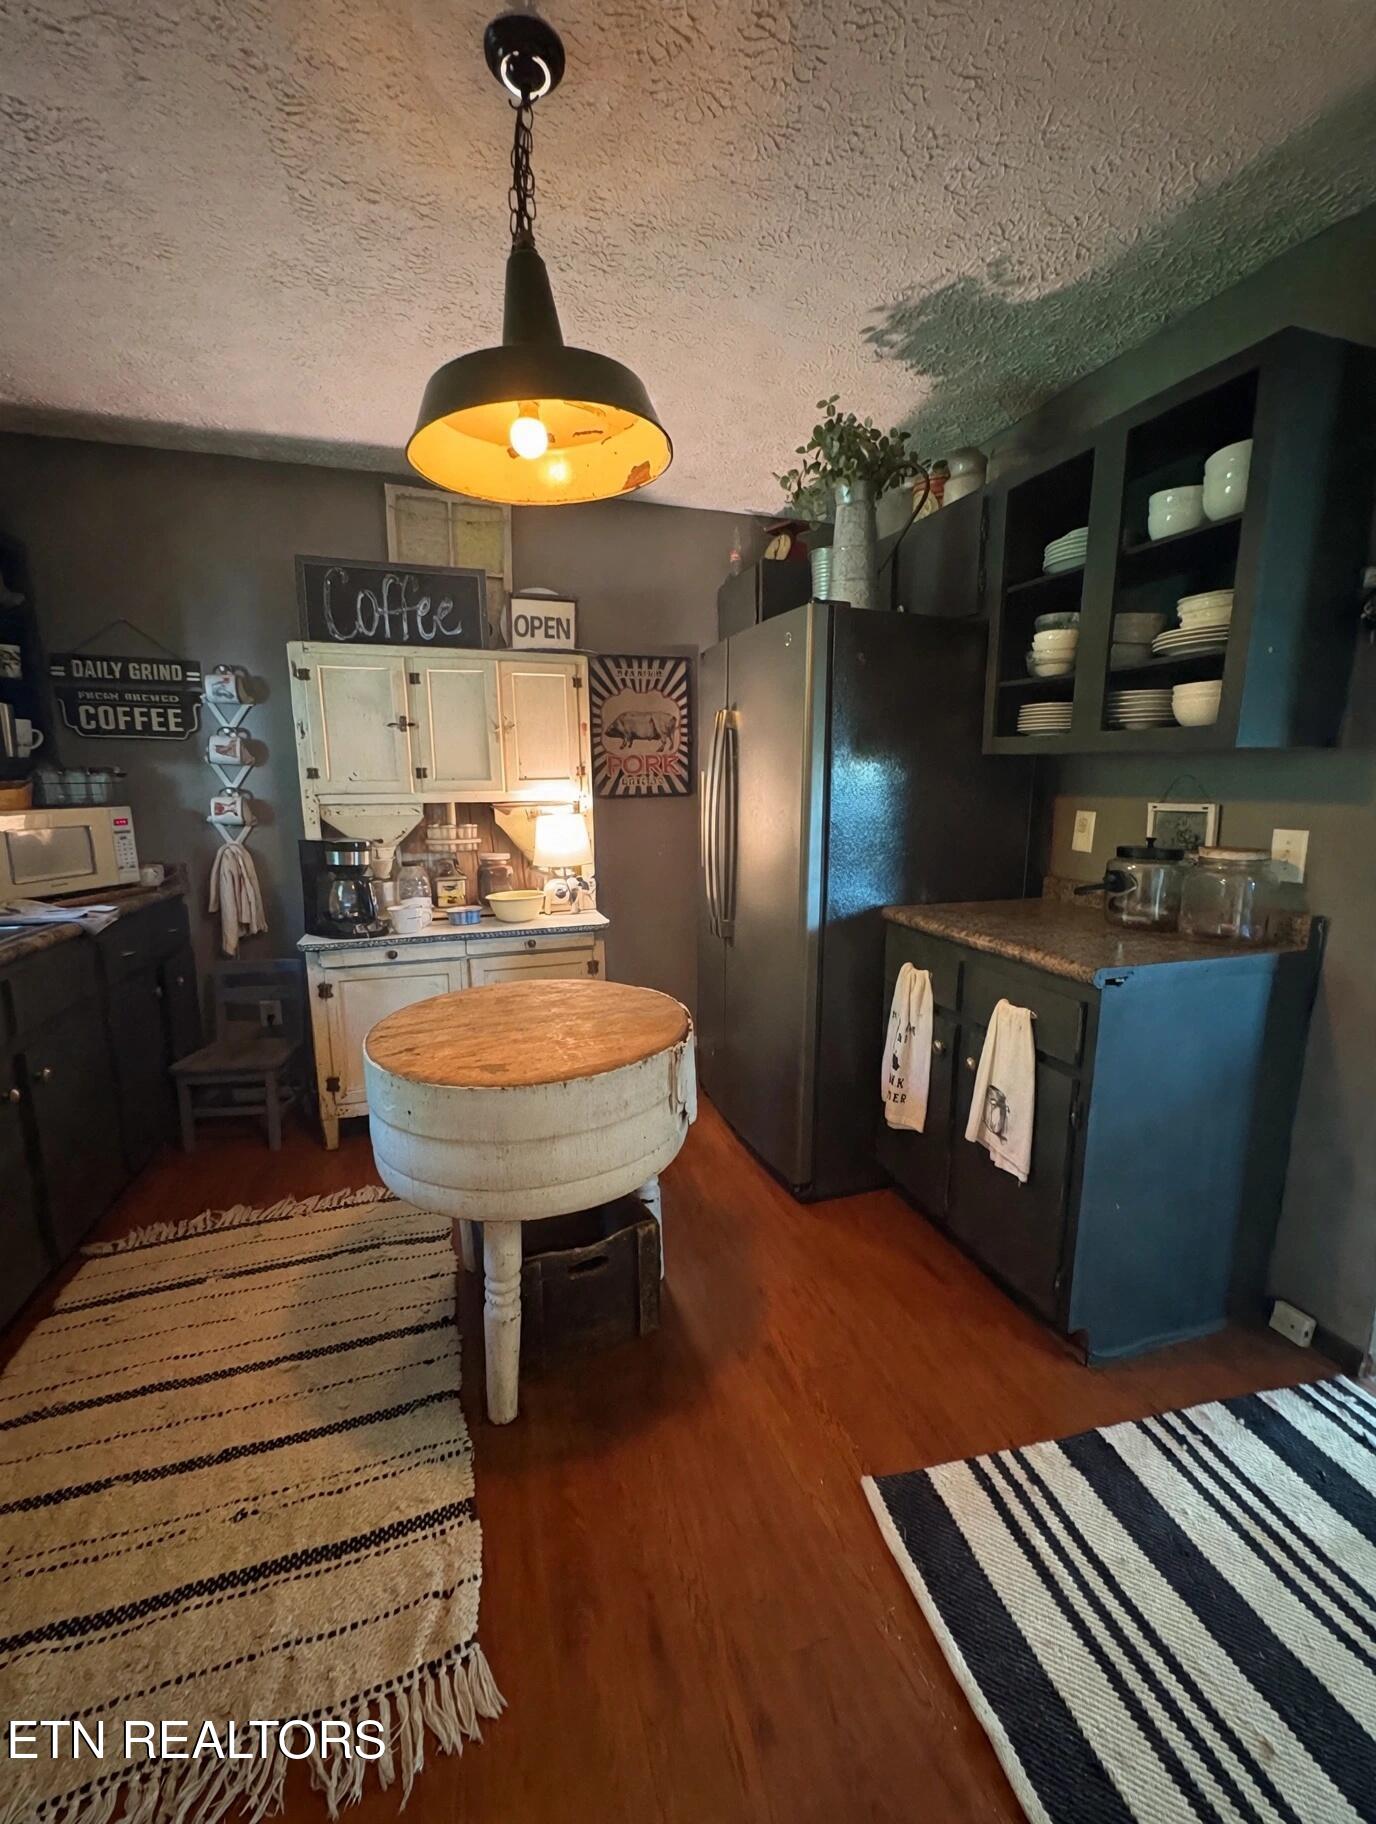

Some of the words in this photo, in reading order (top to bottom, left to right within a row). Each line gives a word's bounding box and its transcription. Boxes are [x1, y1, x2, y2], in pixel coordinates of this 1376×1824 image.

[324, 566, 463, 641] Coffee
[513, 613, 572, 640] OPEN
[71, 659, 123, 679] DAILY
[128, 662, 183, 681] GRIND
[78, 704, 185, 732] COFFEE
[606, 754, 682, 778] PORK
